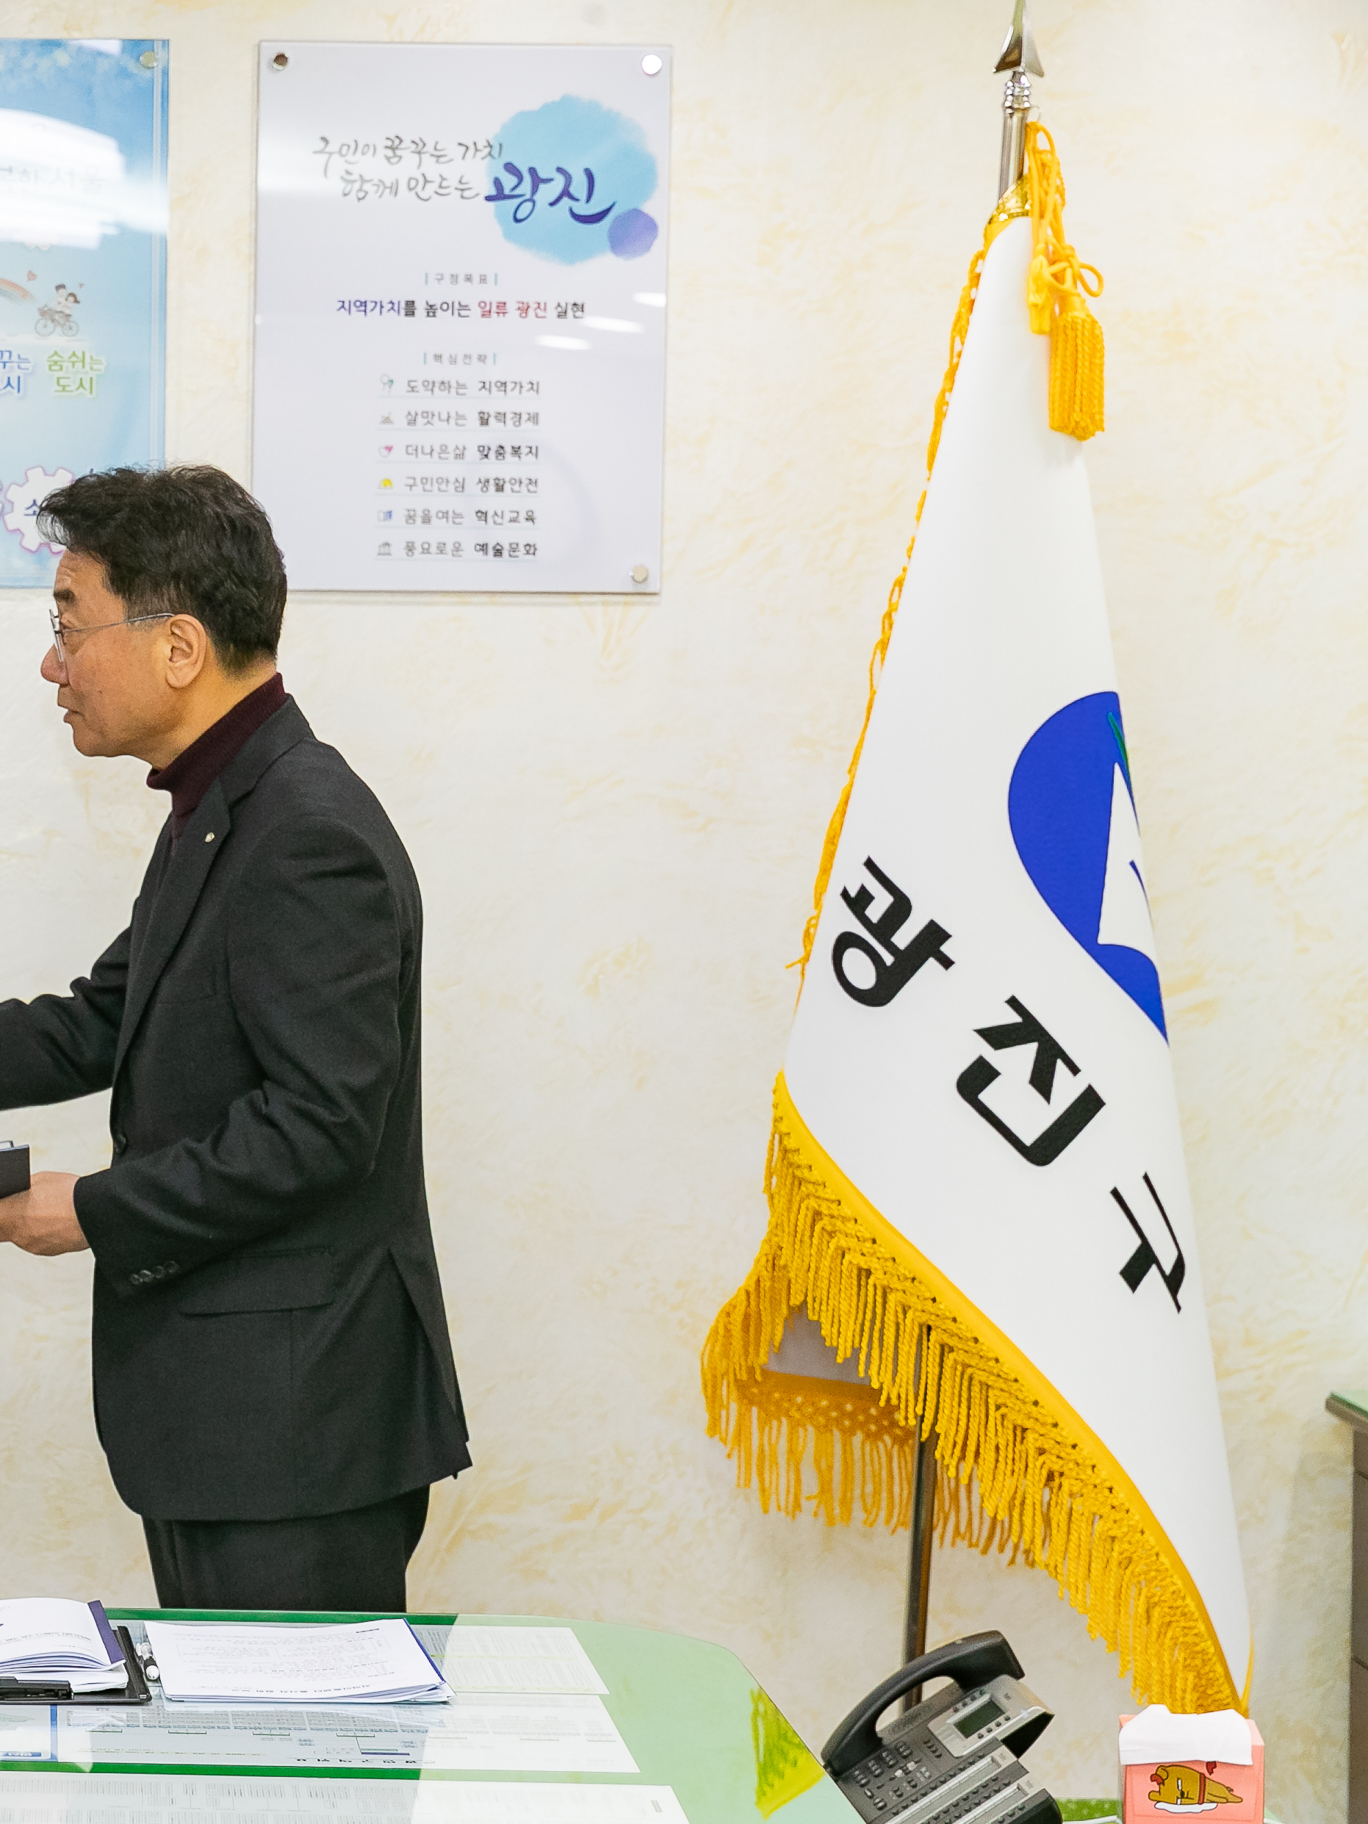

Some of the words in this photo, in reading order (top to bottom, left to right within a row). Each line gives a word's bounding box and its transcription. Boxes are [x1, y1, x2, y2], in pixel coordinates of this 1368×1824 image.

[312, 136, 377, 178] 구민이
[383, 135, 454, 169] 꿈꾸는
[458, 140, 503, 162] 가치
[340, 170, 399, 202] 함께
[407, 173, 481, 201] 만드는
[484, 162, 616, 224] 광진
[336, 299, 417, 318] 지역가치를
[425, 300, 471, 318] 높이는
[478, 300, 509, 319] 일류
[515, 300, 547, 319] 광진
[554, 301, 585, 319] 실현
[46, 350, 105, 373] 숨쉬는
[54, 376, 94, 395] 도시
[406, 379, 468, 396] 도약하는
[478, 380, 539, 396] 지역가치
[404, 476, 466, 493] 구민안심
[476, 476, 538, 494] 생활안전
[831, 855, 1186, 1314] 광진구
